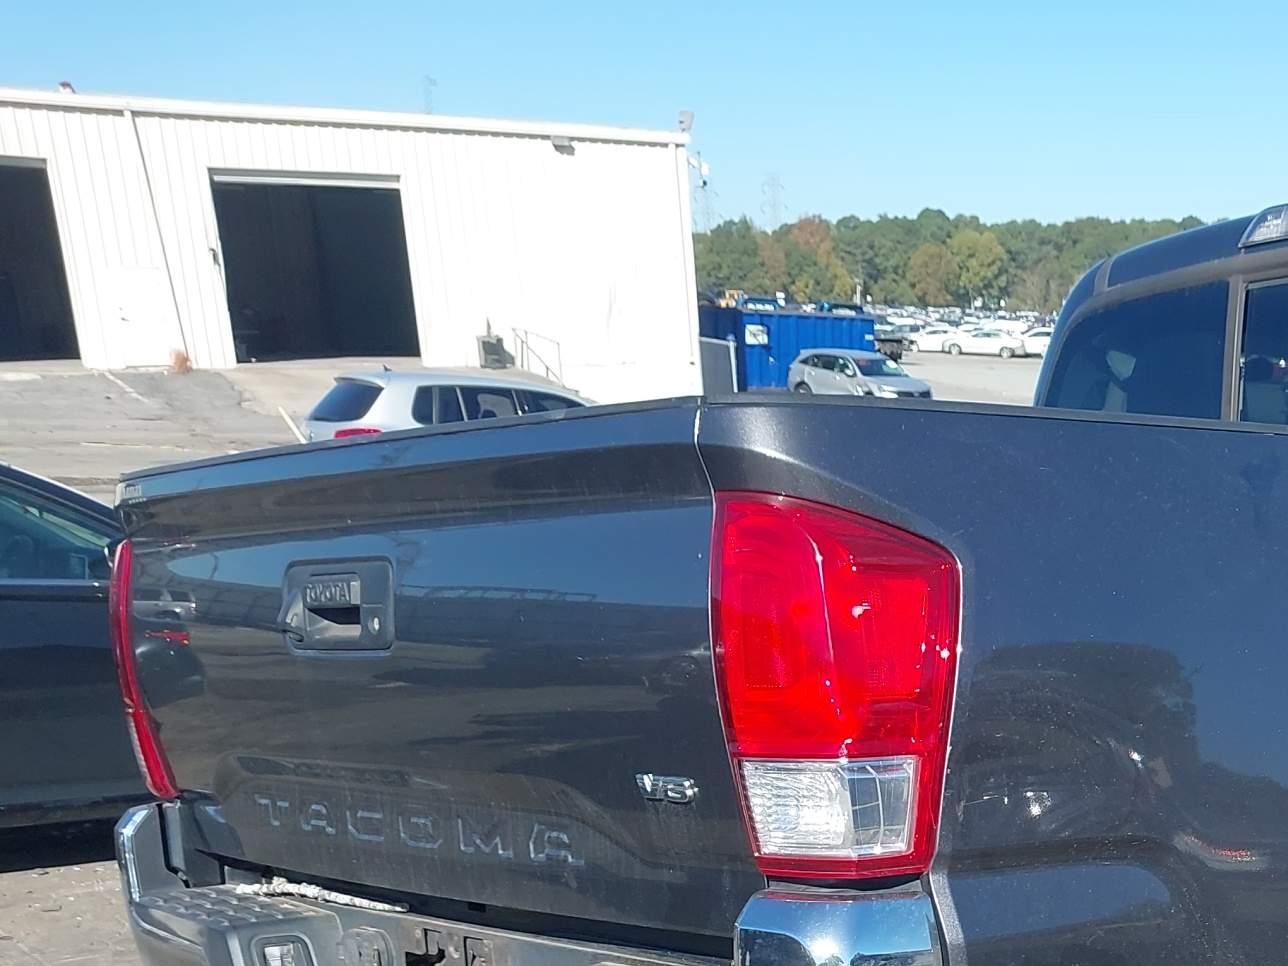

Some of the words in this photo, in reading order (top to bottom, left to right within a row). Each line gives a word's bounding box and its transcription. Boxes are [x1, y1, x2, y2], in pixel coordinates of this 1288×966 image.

[304, 581, 350, 603] TOYOTA
[635, 773, 699, 803] V6
[253, 793, 585, 866] TACOMA
